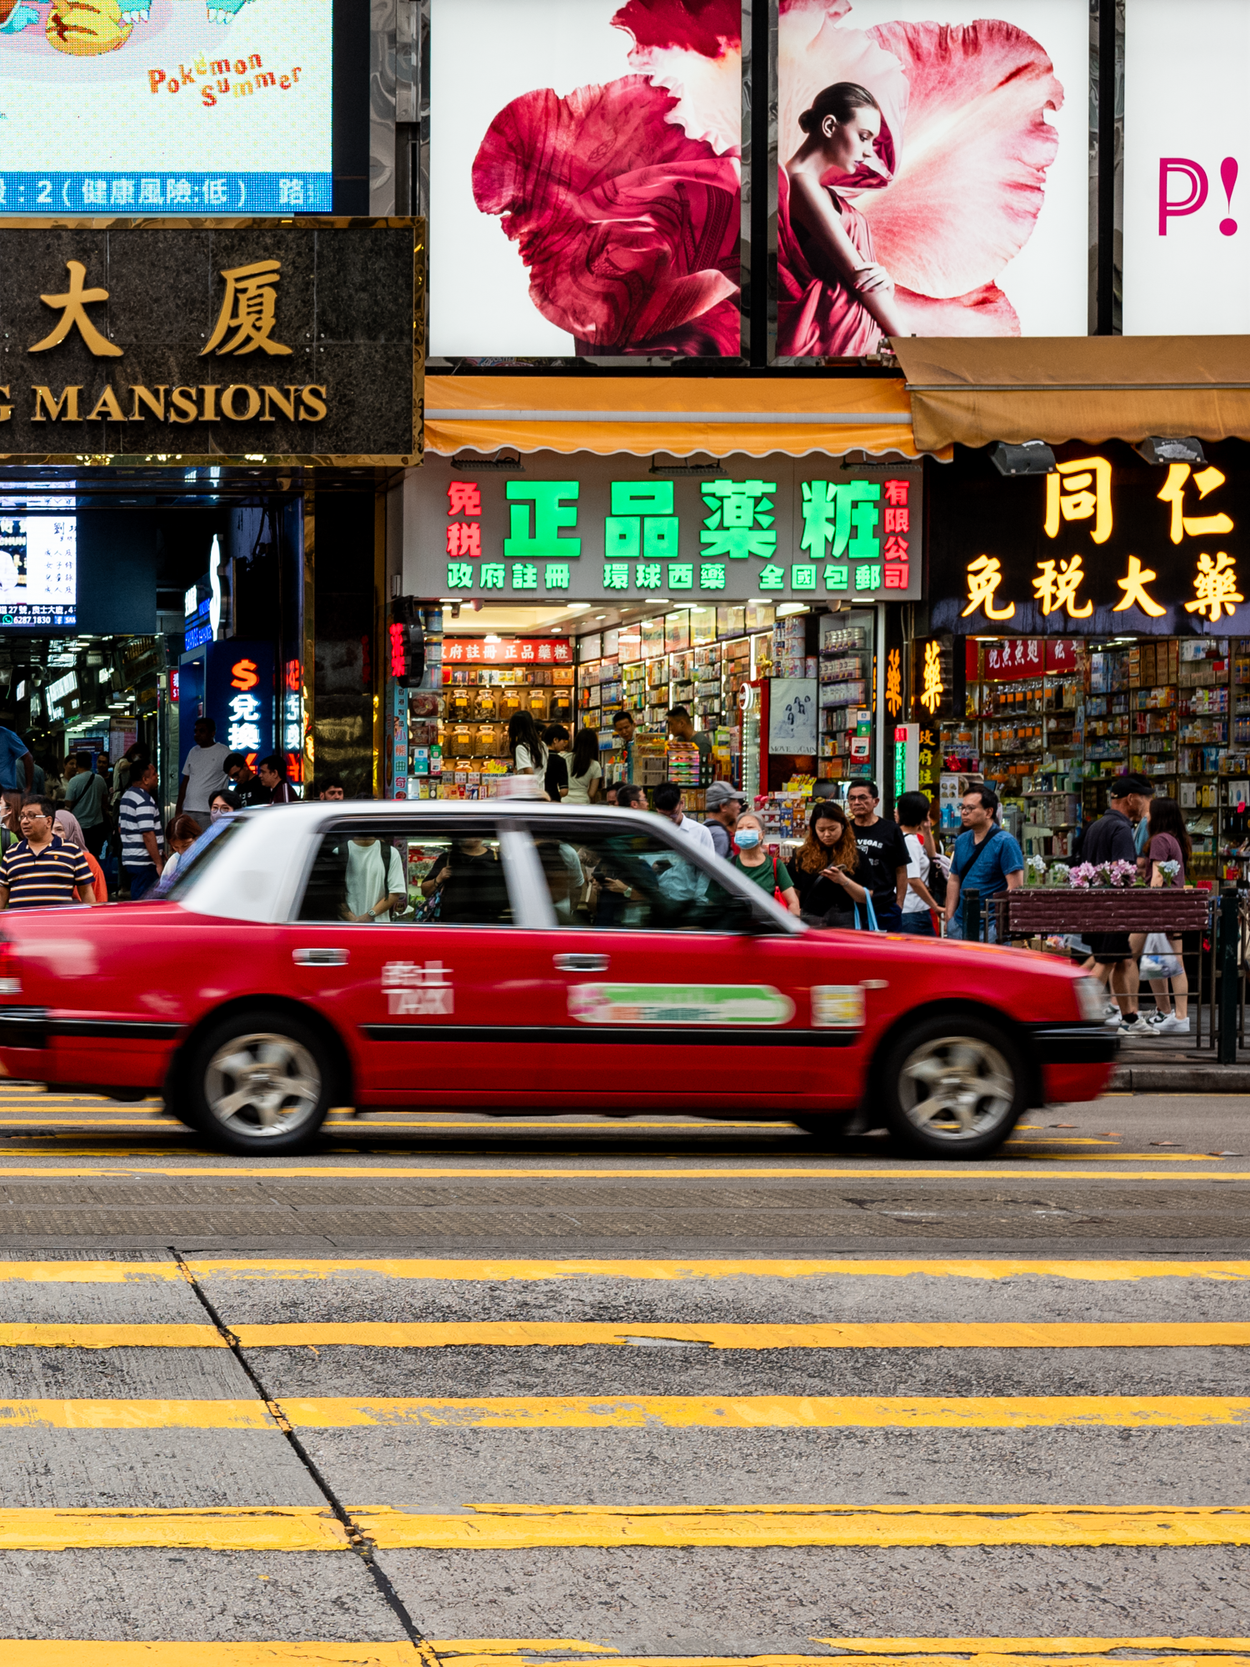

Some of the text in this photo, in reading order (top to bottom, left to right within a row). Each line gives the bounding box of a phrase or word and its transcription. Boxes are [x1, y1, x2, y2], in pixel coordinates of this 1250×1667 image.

[148, 51, 262, 94] Pokémon
[201, 66, 302, 107] Summer
[1158, 156, 1239, 237] P!
[31, 383, 329, 426] MANSIONS
[1043, 456, 1235, 546] 同仁
[883, 479, 911, 590] 有限公司
[447, 563, 882, 590] 政府註冊 環球西藥 全國包郵
[13, 616, 32, 625] 6287
[33, 616, 51, 625] 1830
[857, 839, 883, 849] VEGAS
